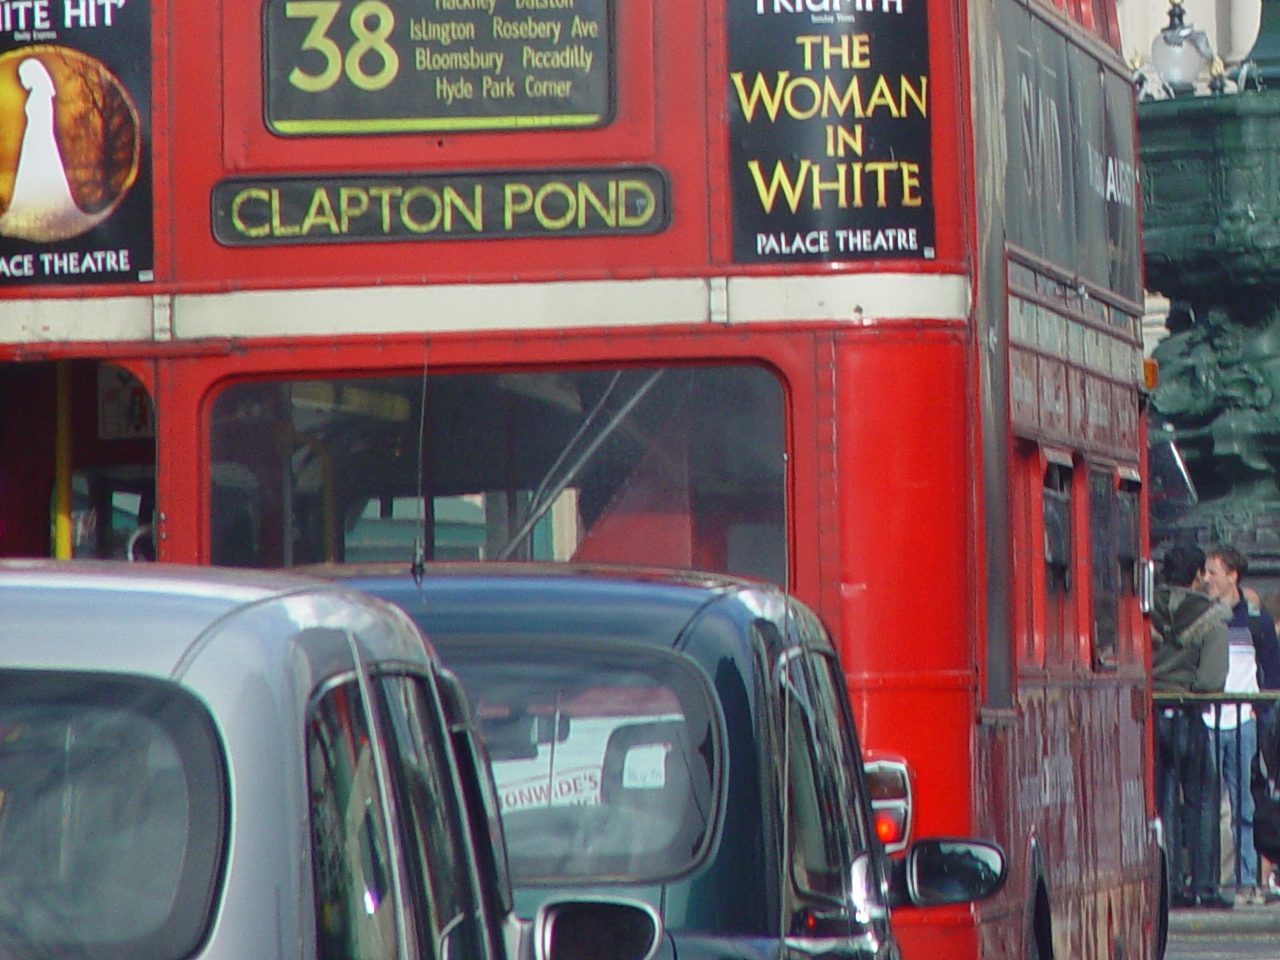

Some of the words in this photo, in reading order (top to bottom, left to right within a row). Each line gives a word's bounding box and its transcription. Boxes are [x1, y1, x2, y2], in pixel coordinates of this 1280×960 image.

[0, 0, 51, 32] ITE
[410, 18, 475, 46] Islington
[492, 16, 562, 41] Rosebery
[571, 15, 599, 38] Ave
[285, 0, 400, 93] 38
[415, 45, 505, 74] Bloomsbury
[522, 44, 594, 73] Piccadilly
[795, 33, 871, 71] THE
[435, 77, 473, 106] Hyde
[482, 75, 516, 99] Park
[525, 74, 573, 98] Corner
[730, 70, 928, 124] WOMAN
[825, 123, 863, 158] IN
[747, 159, 922, 214] WHITE
[231, 184, 483, 238] CLAPTON
[504, 179, 656, 232] POND
[756, 230, 830, 255] PALACE
[834, 228, 918, 252] THEATRE
[40, 249, 131, 275] THEATRE
